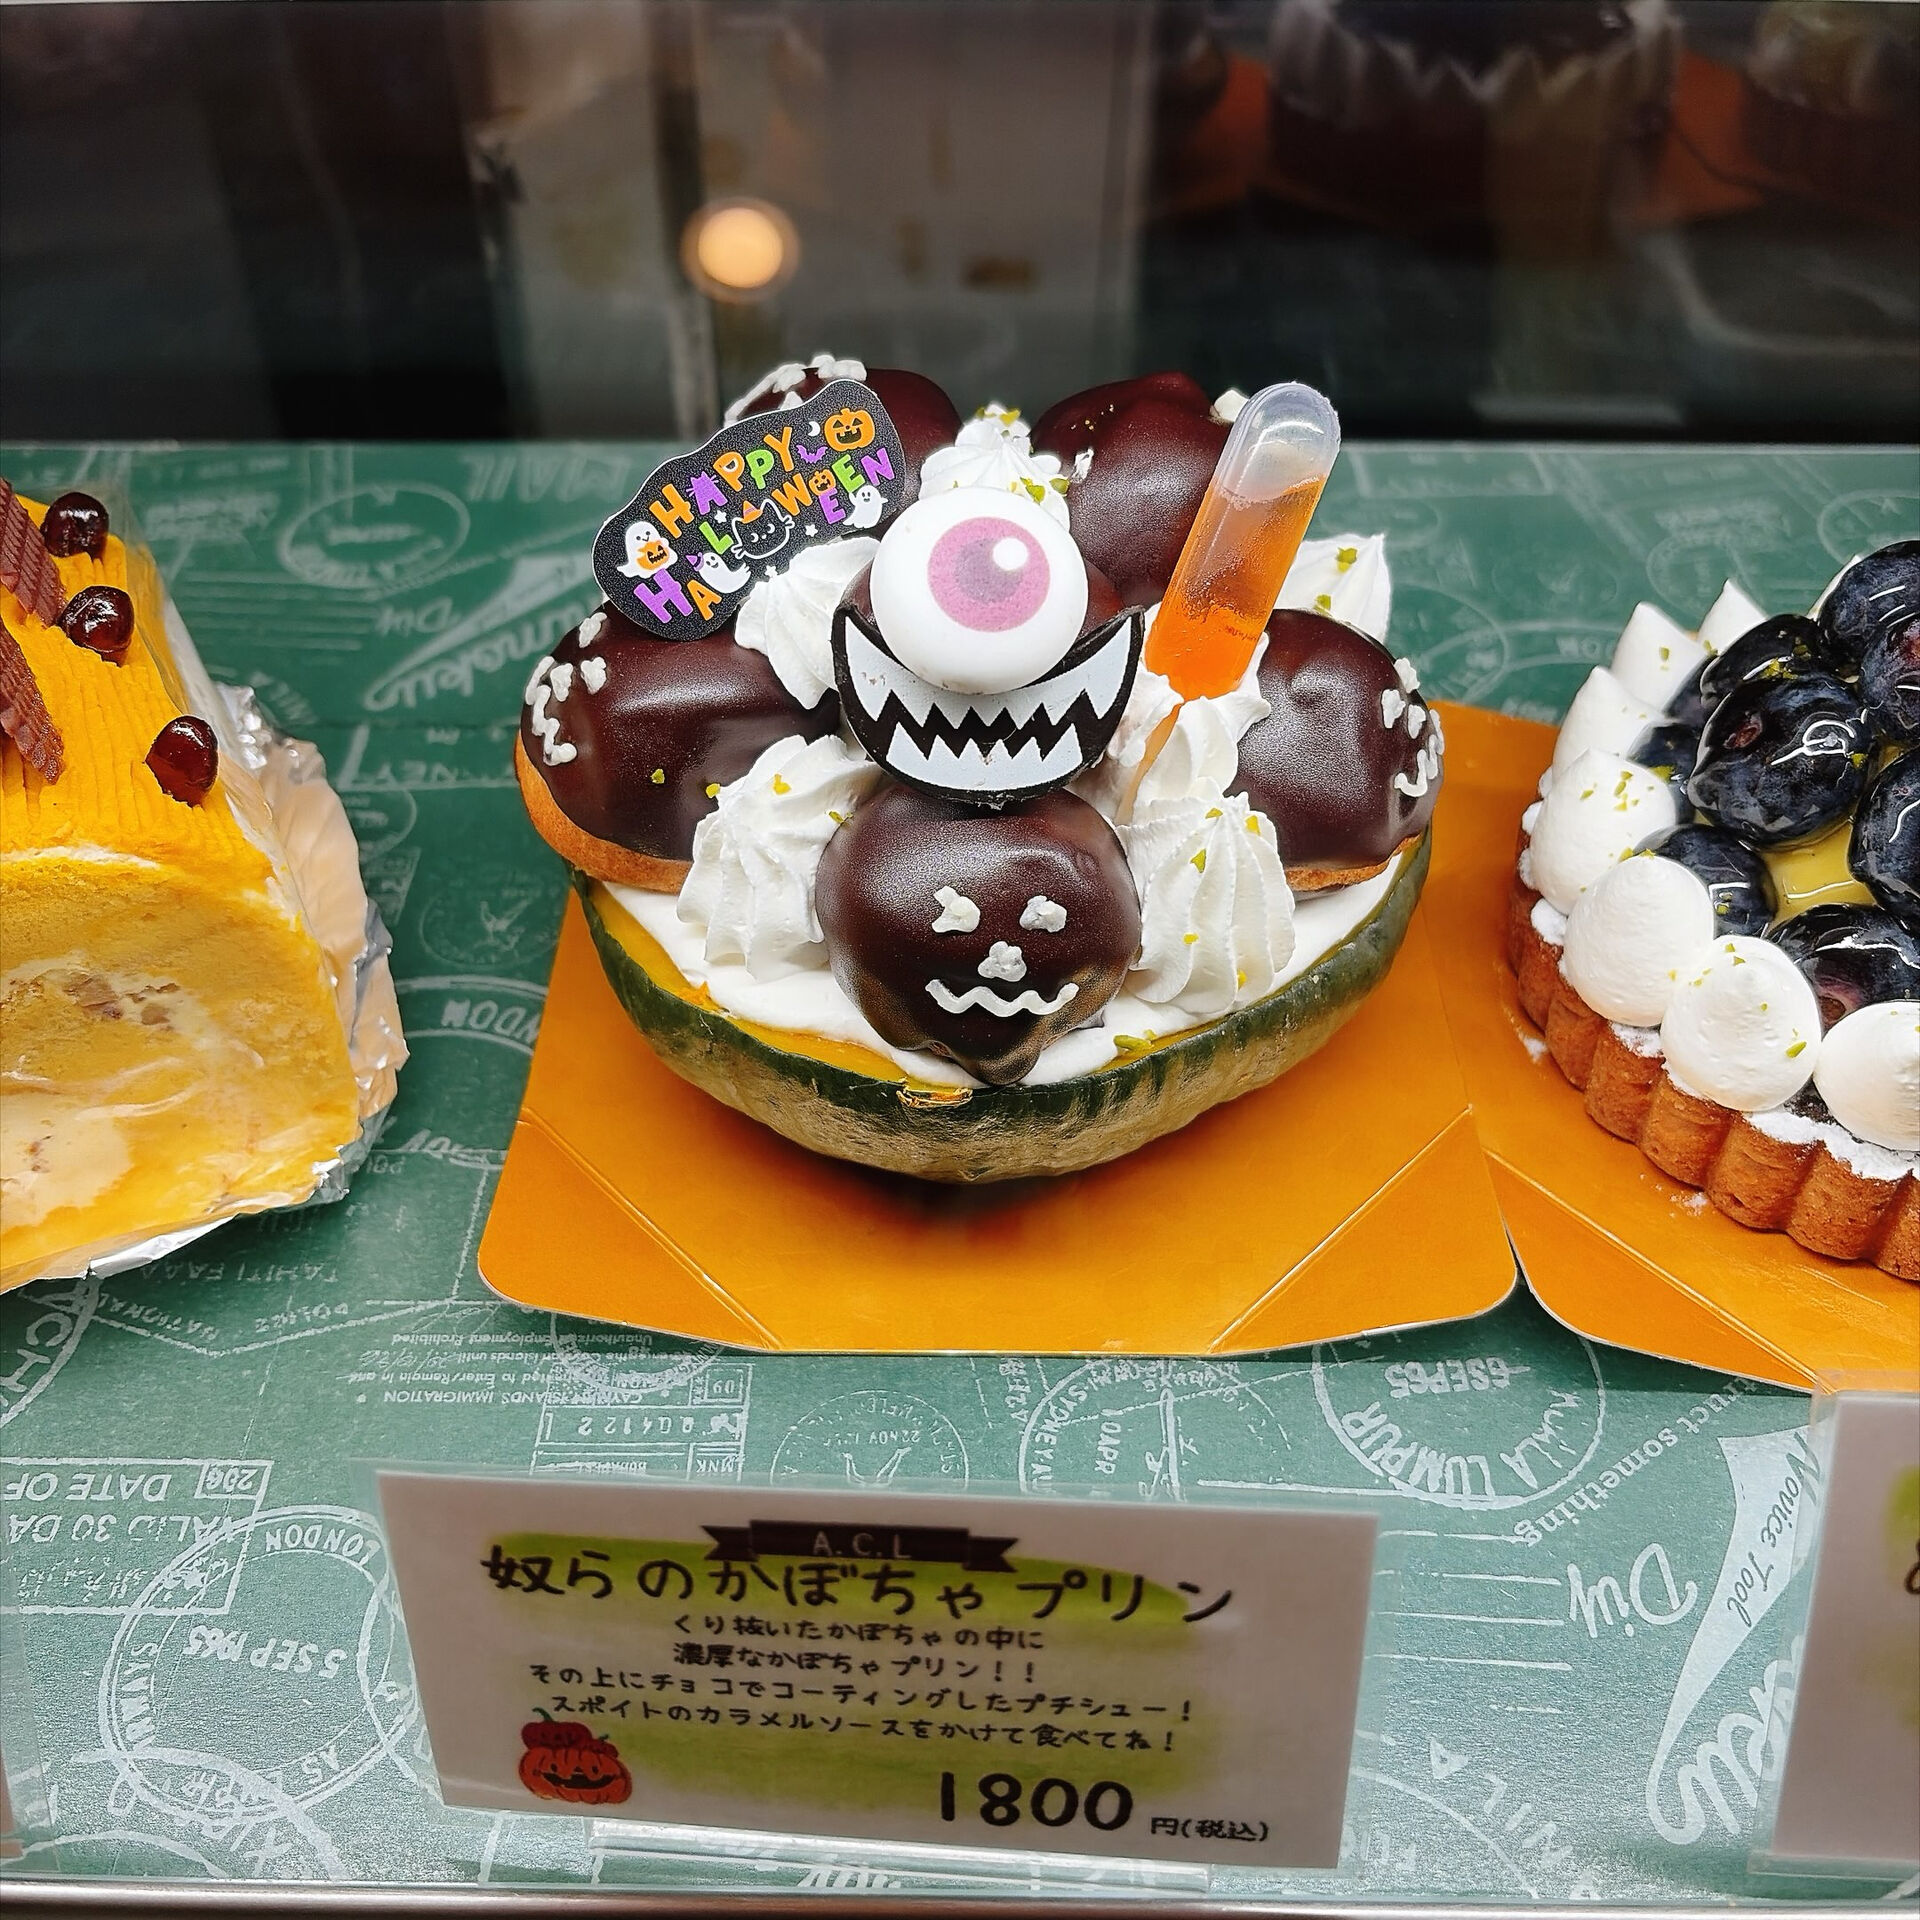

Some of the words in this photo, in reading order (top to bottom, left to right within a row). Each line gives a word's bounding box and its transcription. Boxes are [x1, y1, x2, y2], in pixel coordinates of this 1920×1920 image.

[649, 426, 794, 540] HAPPY
[383, 1389, 494, 1404] IMMIGRATION
[66, 1471, 172, 1502] DATE
[1512, 1427, 1679, 1548] something
[264, 1523, 381, 1563] LONDON
[480, 1543, 1233, 1625] 奴らのかぼちゃプリン
[1566, 1543, 1698, 1639] Diy
